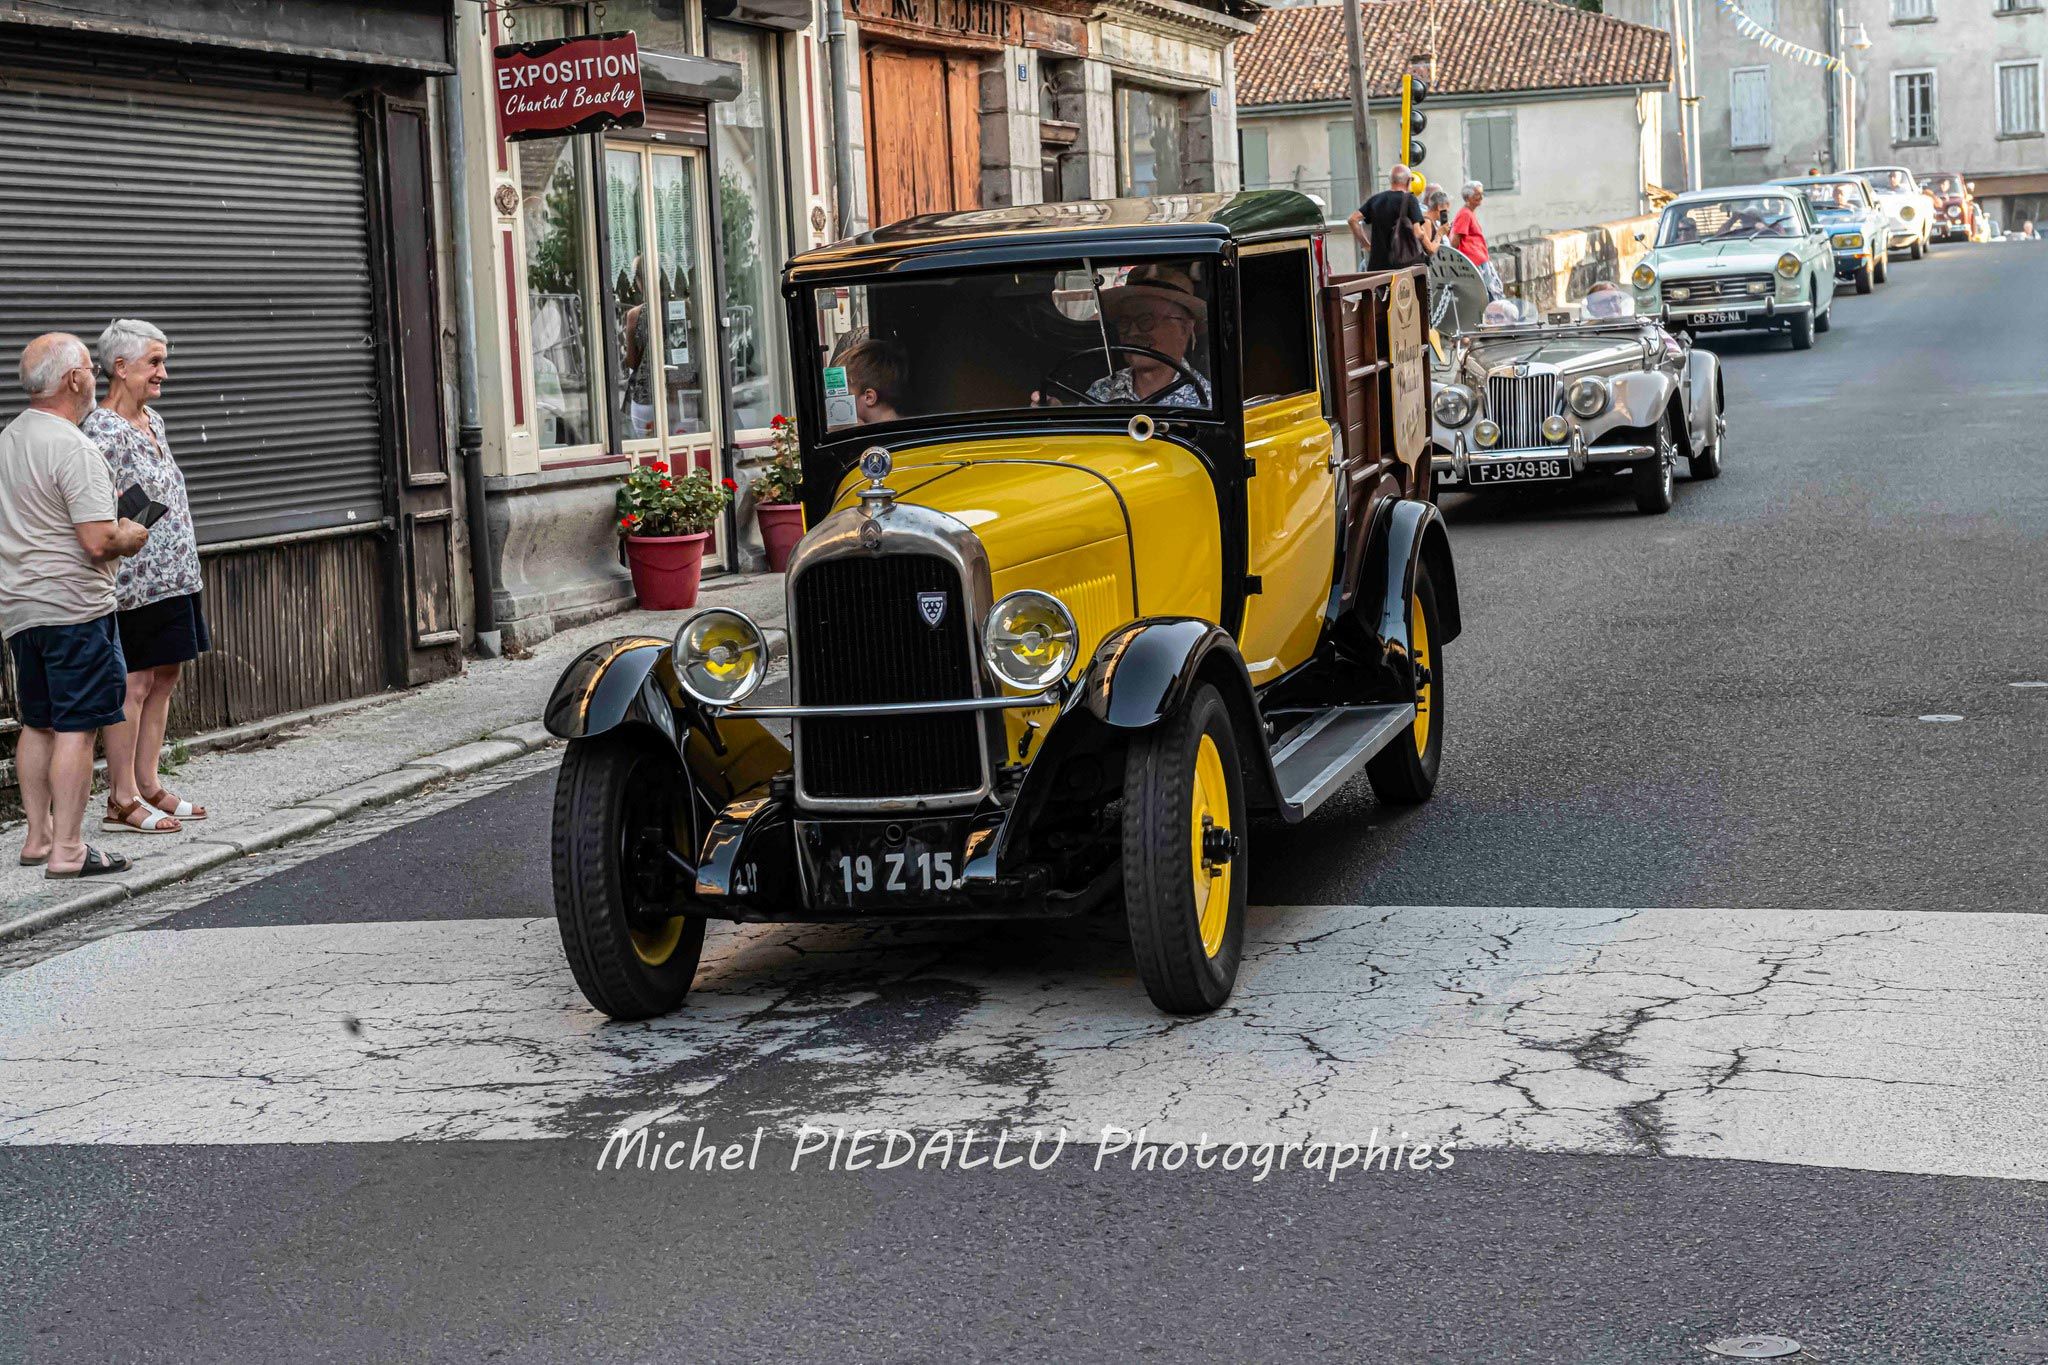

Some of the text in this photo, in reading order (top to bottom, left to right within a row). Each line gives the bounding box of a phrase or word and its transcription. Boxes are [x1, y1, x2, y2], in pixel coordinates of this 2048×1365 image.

[498, 53, 637, 90] EXPOSITION
[505, 82, 635, 116] Chantal Beaslay
[1480, 460, 1560, 481] FJ-949-BG
[839, 852, 953, 893] 19 Z 15
